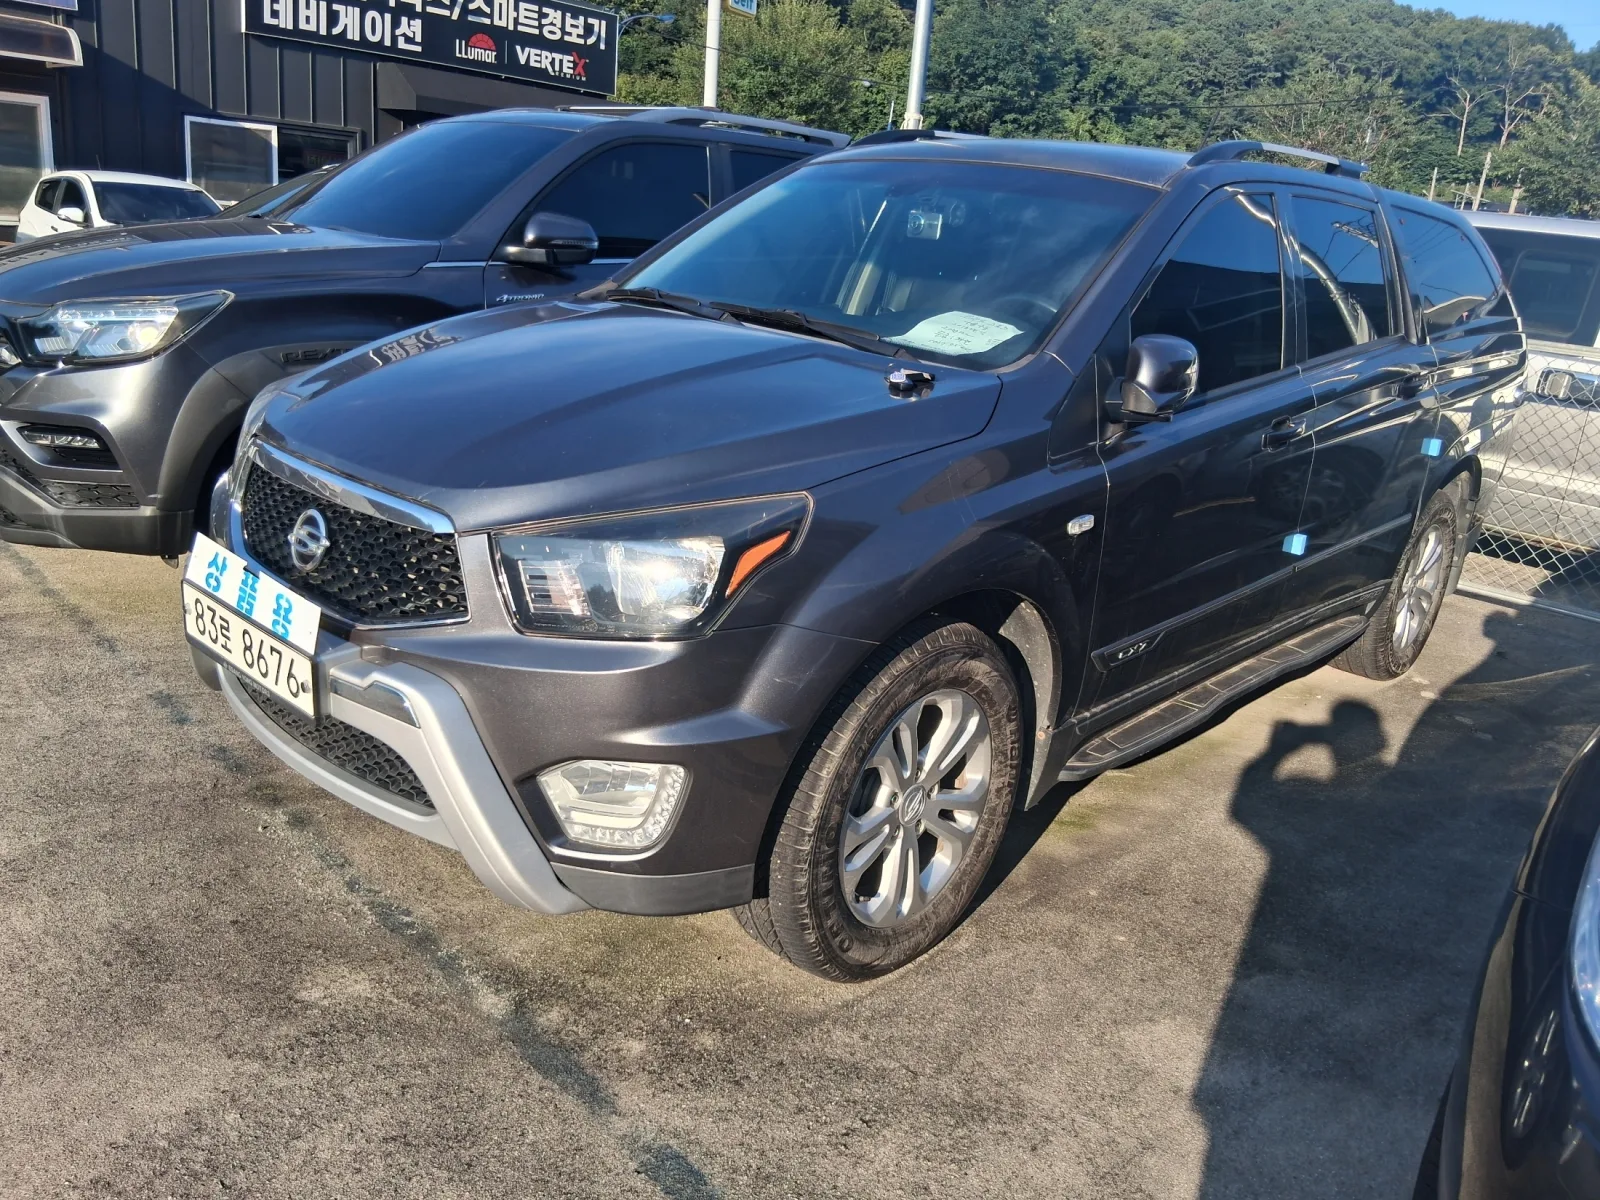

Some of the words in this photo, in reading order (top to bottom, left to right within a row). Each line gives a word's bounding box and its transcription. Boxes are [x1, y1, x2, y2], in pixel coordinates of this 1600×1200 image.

[263, 0, 422, 52] 네비게이션
[515, 44, 587, 76] VERTEX
[194, 597, 233, 654] 83로
[242, 628, 300, 699] 8676
